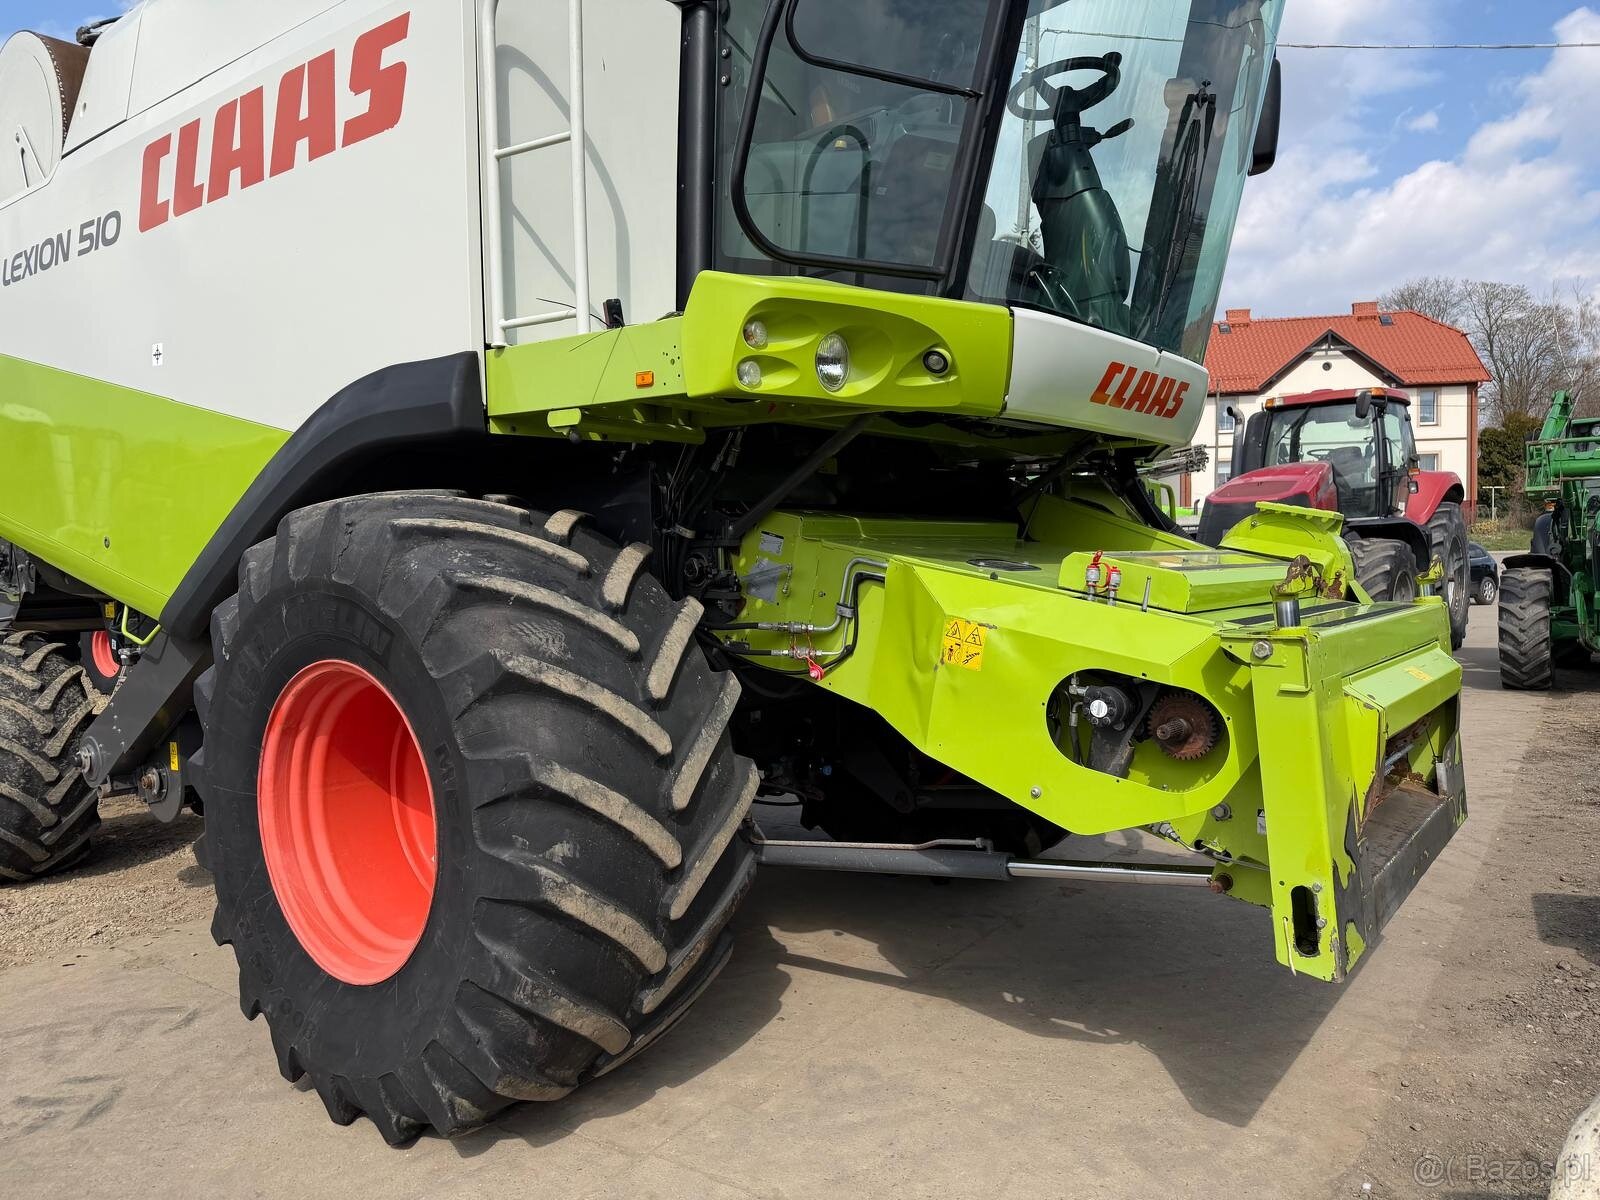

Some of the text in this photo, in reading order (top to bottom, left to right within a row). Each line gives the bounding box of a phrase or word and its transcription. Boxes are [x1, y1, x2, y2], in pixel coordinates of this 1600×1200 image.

[138, 10, 411, 233] CLAAS
[2, 210, 122, 287] LEXION 510
[1089, 361, 1191, 419] CLAAS
